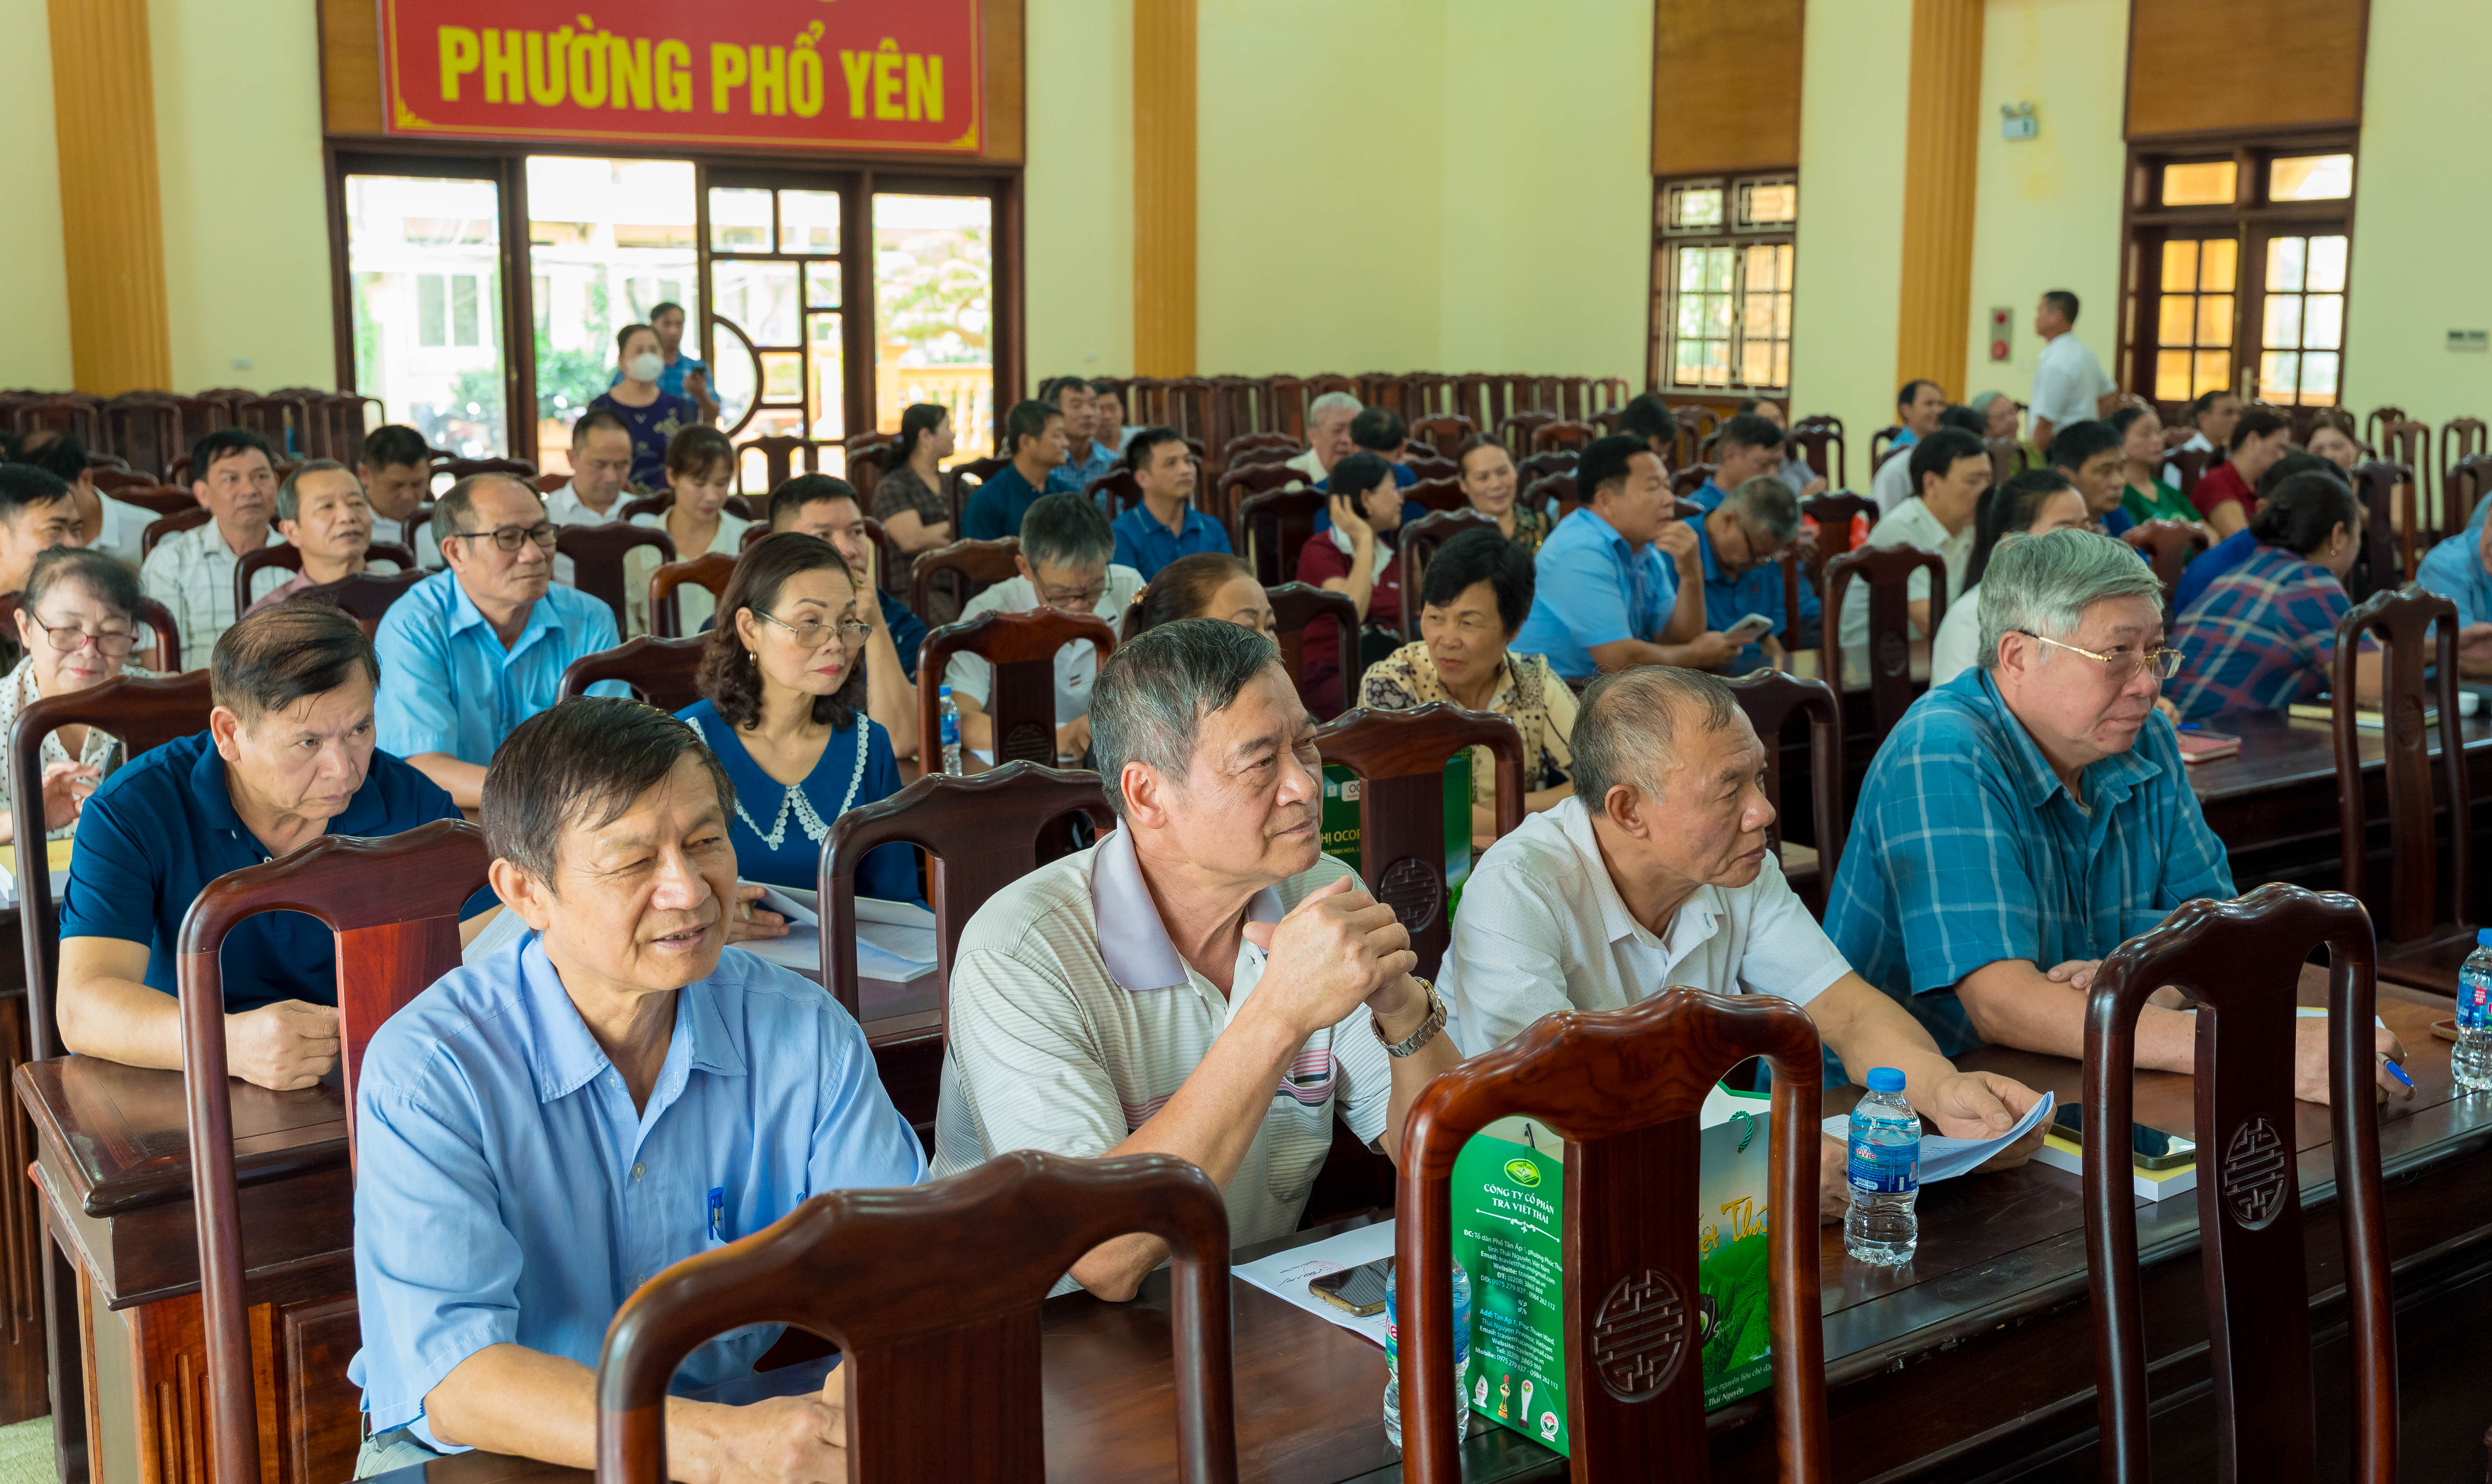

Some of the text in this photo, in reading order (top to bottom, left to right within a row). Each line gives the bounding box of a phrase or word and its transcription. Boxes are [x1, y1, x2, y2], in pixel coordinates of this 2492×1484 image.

[439, 15, 944, 122] PHƯỜNG PHỔ YÊN
[1320, 832, 1331, 846] HỊ
[1484, 1184, 1509, 1197] CÔNG
[1511, 1190, 1523, 1199] TY
[1492, 1197, 1548, 1224] TRÀ VIỆT THÁI
[1720, 1196, 1767, 1242] Thá
[1464, 1229, 1474, 1237] ĐC:
[1481, 1250, 1555, 1285] Email: travietthai.vn@gmail.com
[1499, 1249, 1511, 1257] Thái
[1540, 1264, 1550, 1274] Nam
[1481, 1275, 1491, 1283] DĐ:
[1491, 1278, 1505, 1287] 0975
[1529, 1291, 1539, 1301] 0984
[1493, 1263, 1546, 1288] Website: travietthai.vn
[1508, 1275, 1523, 1286] (0208)
[1524, 1280, 1535, 1290] 3865
[1480, 1308, 1493, 1317] Add:
[1494, 1312, 1503, 1321] Tan
[1504, 1316, 1512, 1325] Ap
[1519, 1321, 1529, 1331] Phuc
[1530, 1326, 1543, 1338] Thuan
[1543, 1333, 1555, 1346] Ward,
[1482, 1318, 1553, 1353] Thai Nguyen Province, Vietnam
[1479, 1325, 1554, 1362] Email: travietthai.vn@gmail.com
[1491, 1337, 1544, 1365] Website: travietthai.vn
[1475, 1347, 1496, 1359] Mobile:
[1496, 1354, 1508, 1364] 0975
[1508, 1359, 1517, 1368] 279
[1530, 1369, 1542, 1379] 0984
[1507, 1350, 1520, 1361] (0208)
[1521, 1356, 1533, 1366] 3865
[1533, 1362, 1542, 1371] 869
[1719, 1376, 1739, 1391] nguyên
[1741, 1372, 1751, 1381] liệu
[1752, 1366, 1762, 1376] chè
[1708, 1387, 1744, 1406] Thái Nguyên
